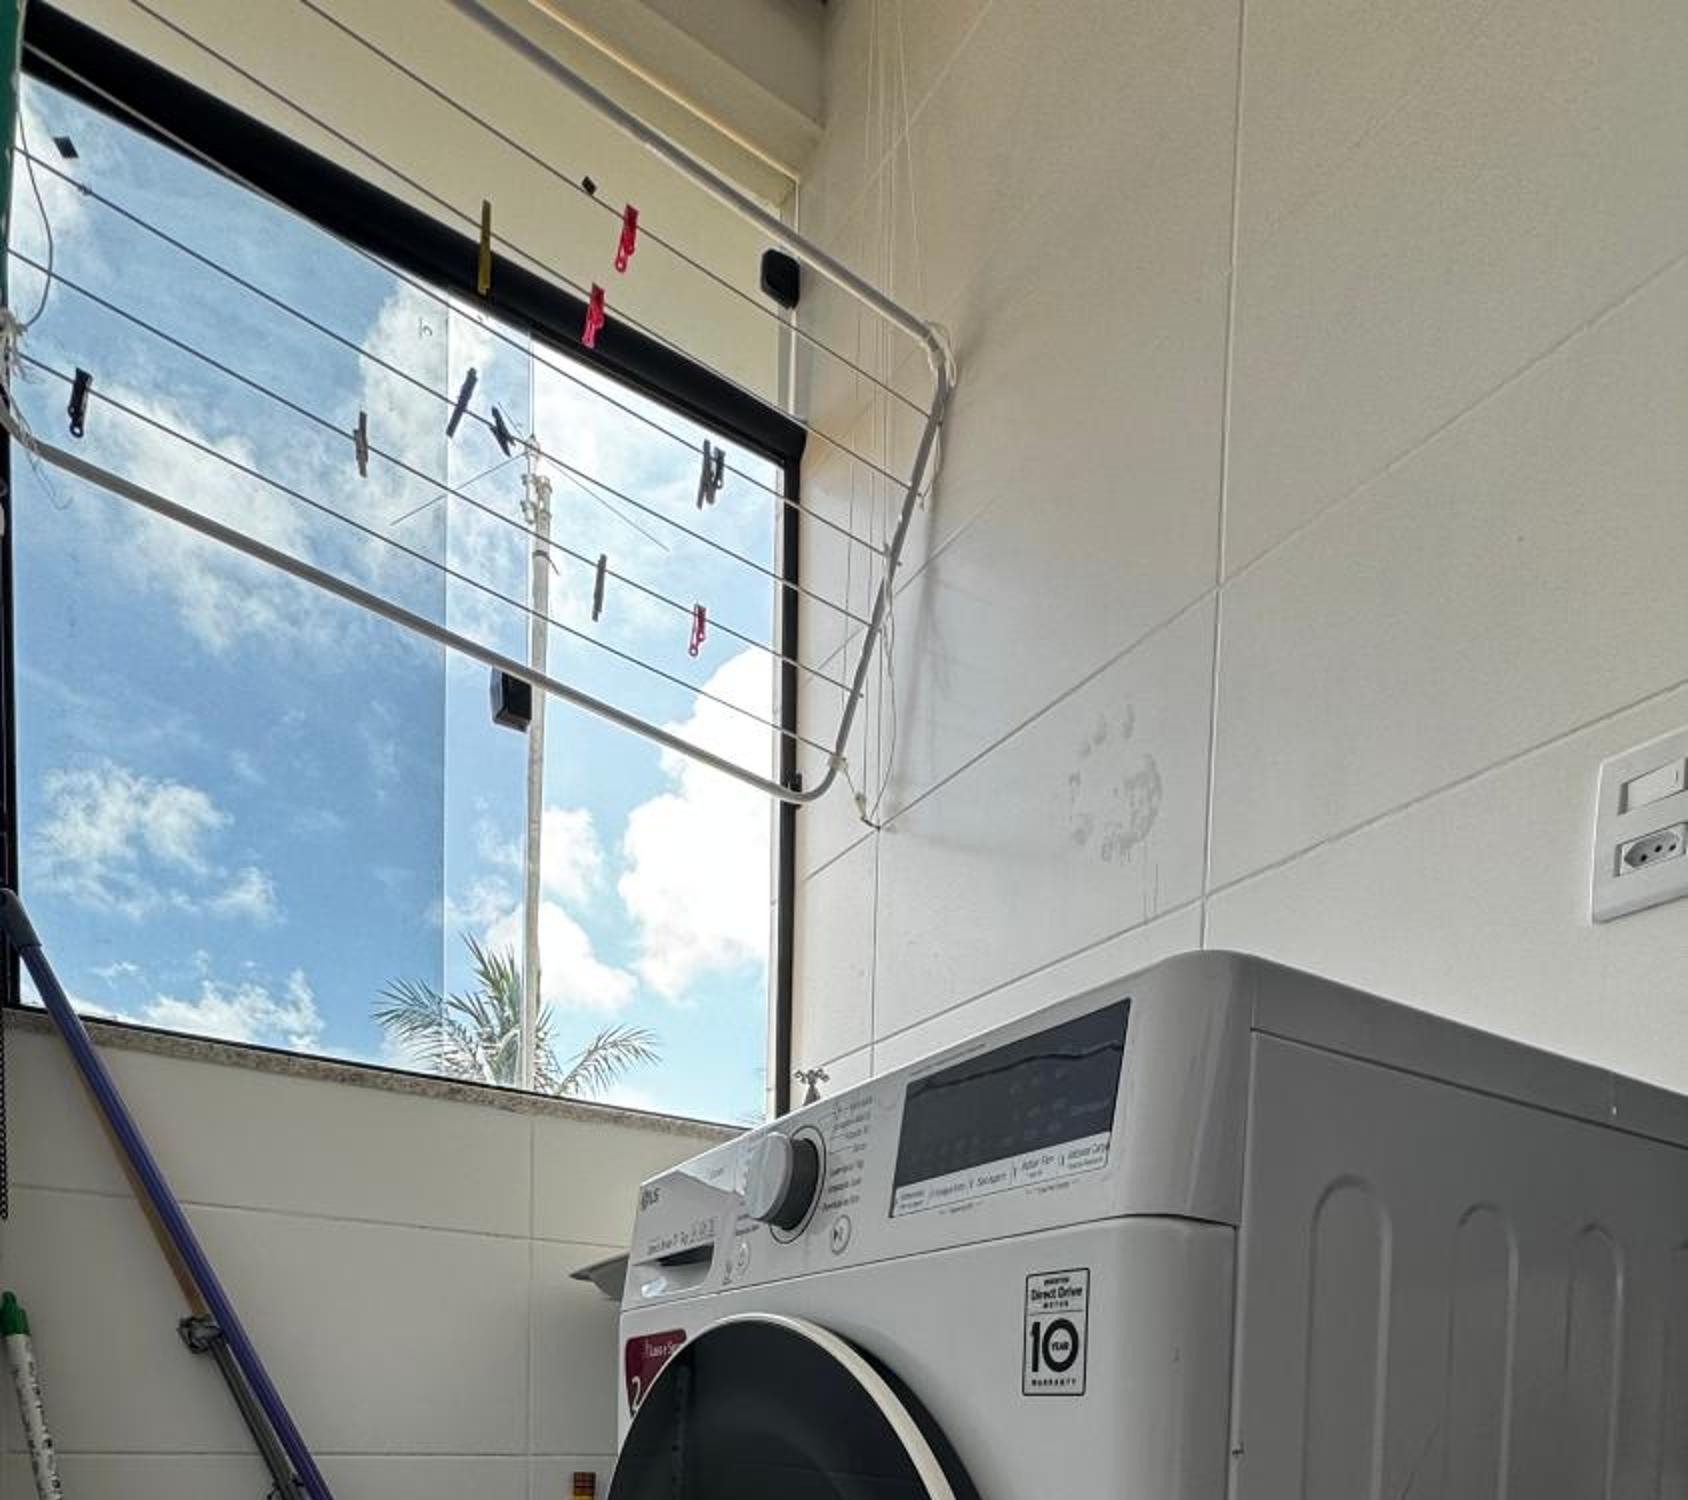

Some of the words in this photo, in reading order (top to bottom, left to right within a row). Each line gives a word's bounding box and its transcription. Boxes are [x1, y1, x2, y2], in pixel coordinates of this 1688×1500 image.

[1031, 1288, 1056, 1301] Direct
[1057, 1285, 1083, 1299] Drive
[1031, 1317, 1079, 1373] 10
